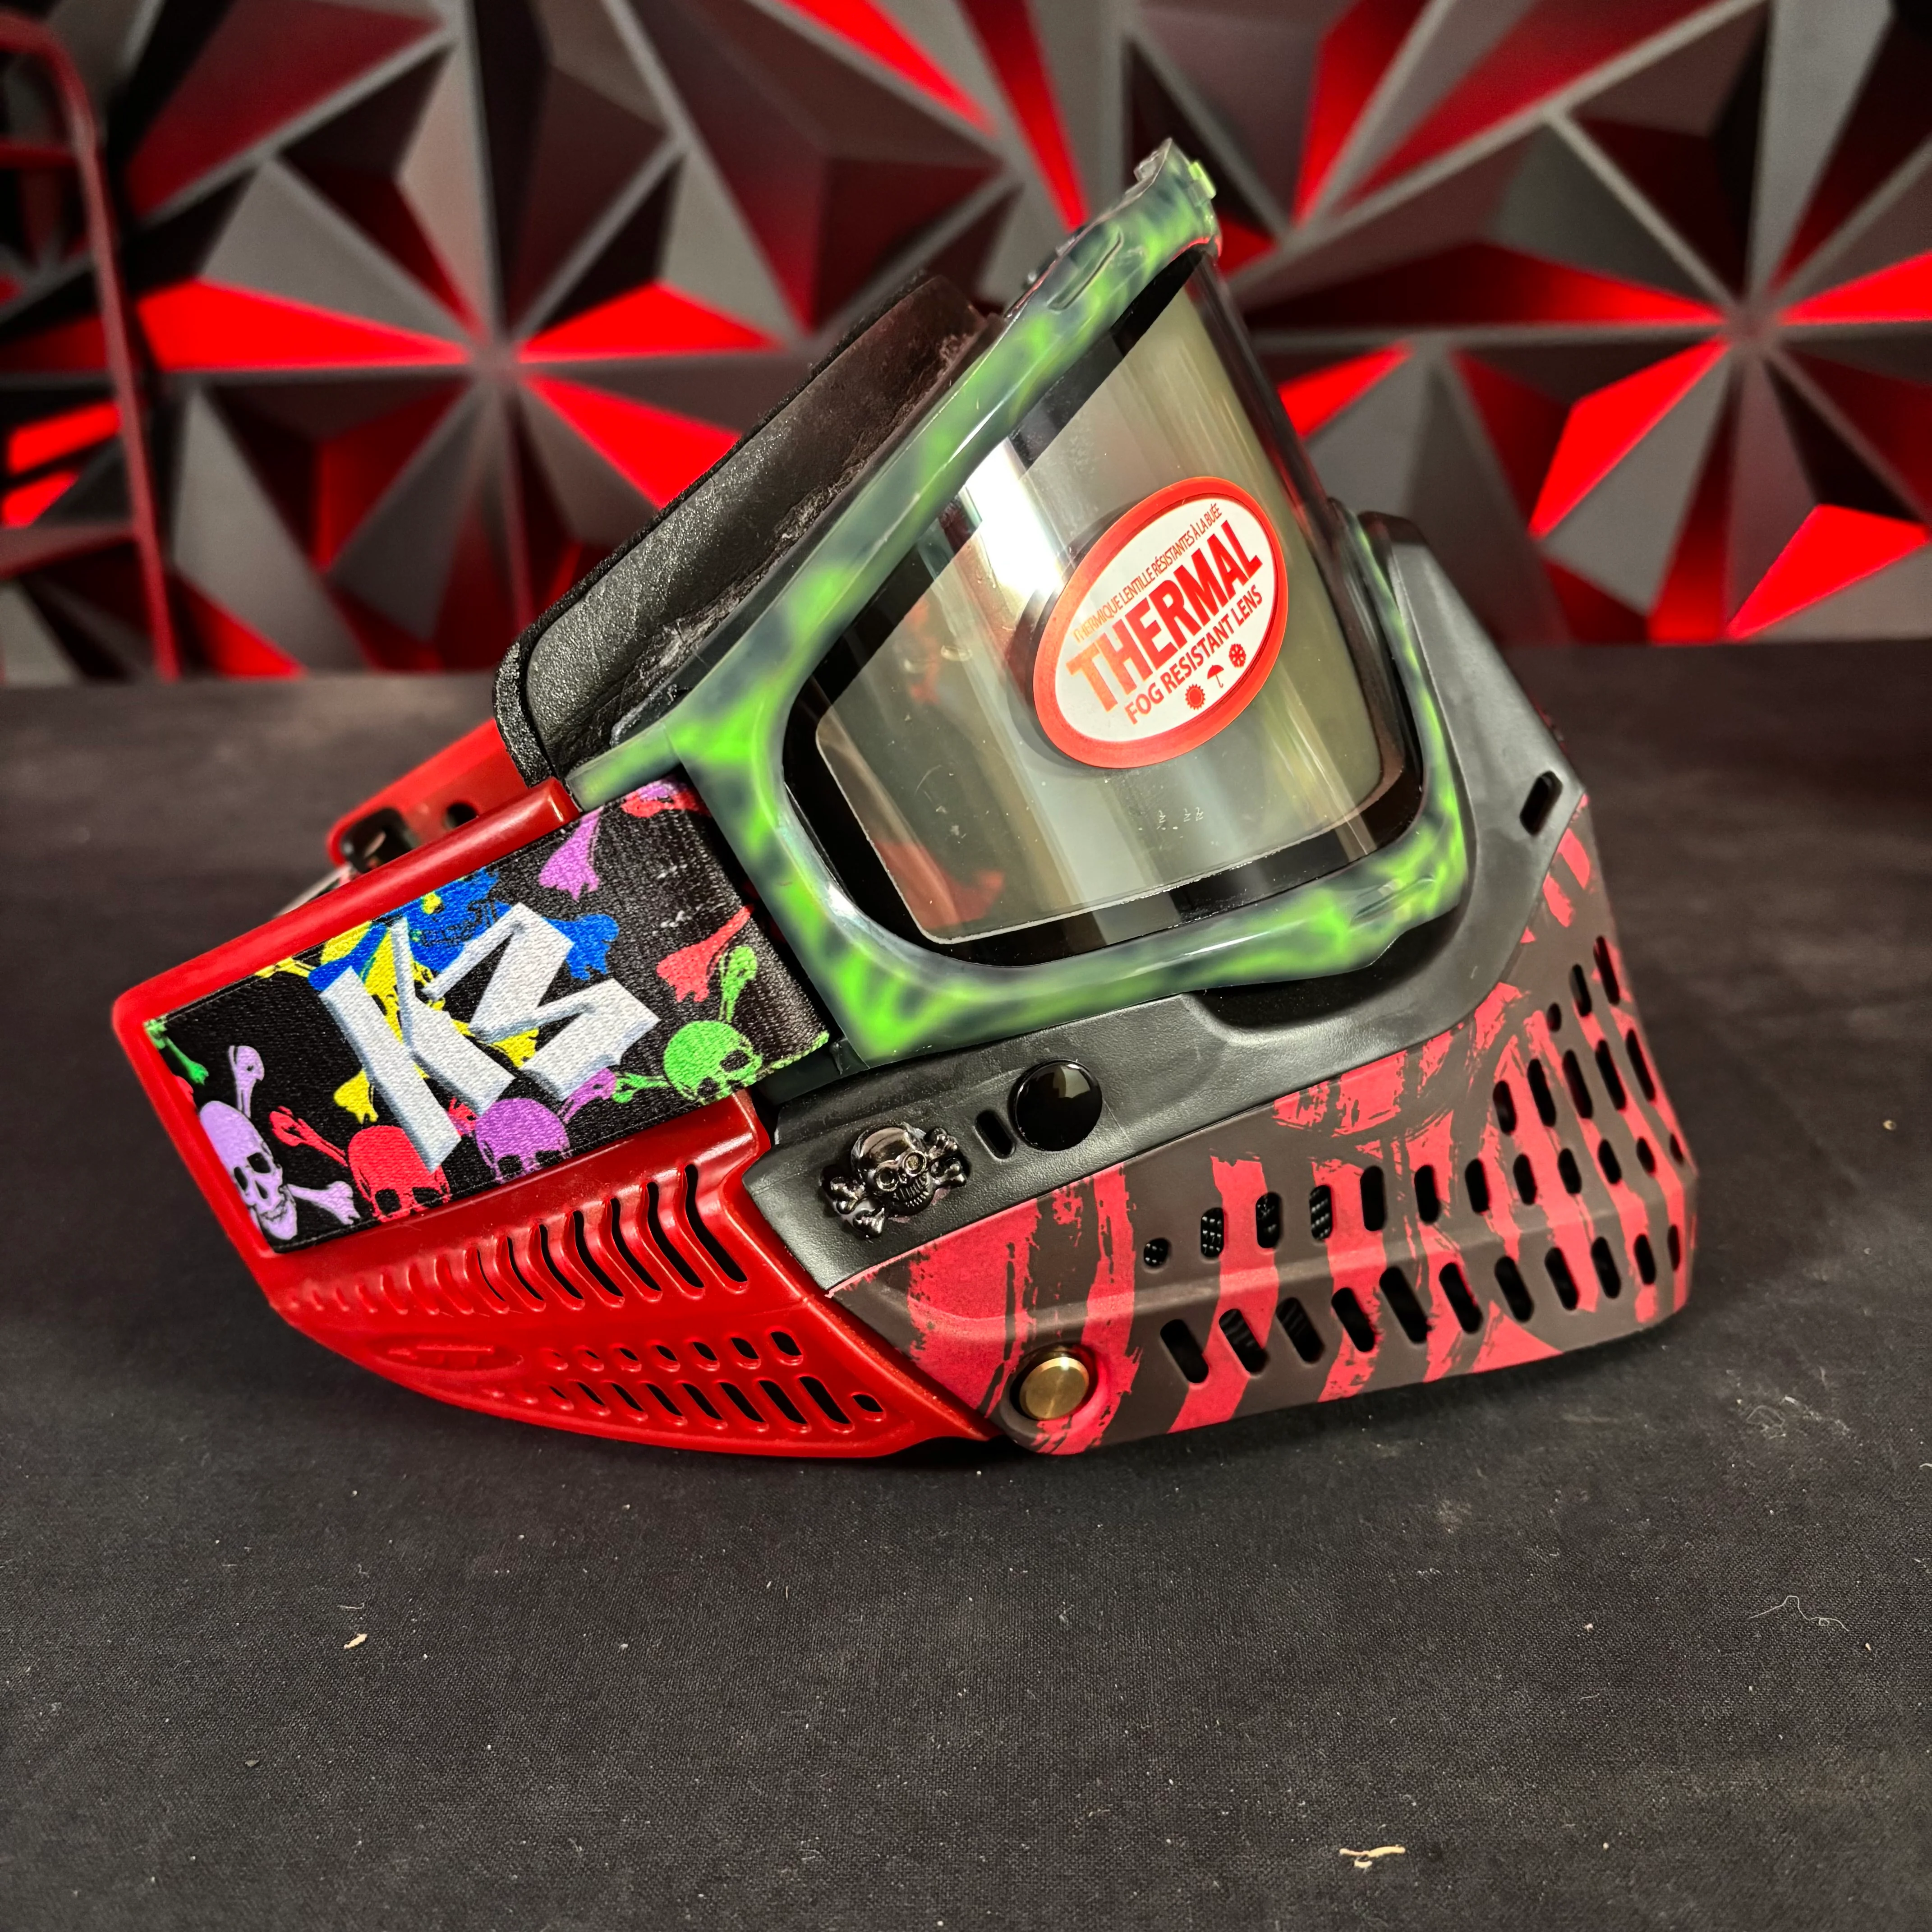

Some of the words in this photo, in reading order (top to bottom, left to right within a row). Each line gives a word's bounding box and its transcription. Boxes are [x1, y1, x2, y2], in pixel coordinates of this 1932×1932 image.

[1066, 520, 1263, 712] THERMAL
[1073, 595, 1123, 643] THERMIQUE
[1118, 567, 1155, 605] LENTILLE
[1151, 530, 1195, 577] RÉSISTANTES
[1190, 524, 1201, 540] À
[1196, 518, 1209, 535] LA
[1204, 503, 1222, 527] BUÉE
[1124, 682, 1164, 725] FOG
[1160, 613, 1234, 695] RESISTANT
[1230, 584, 1262, 627] LENS
